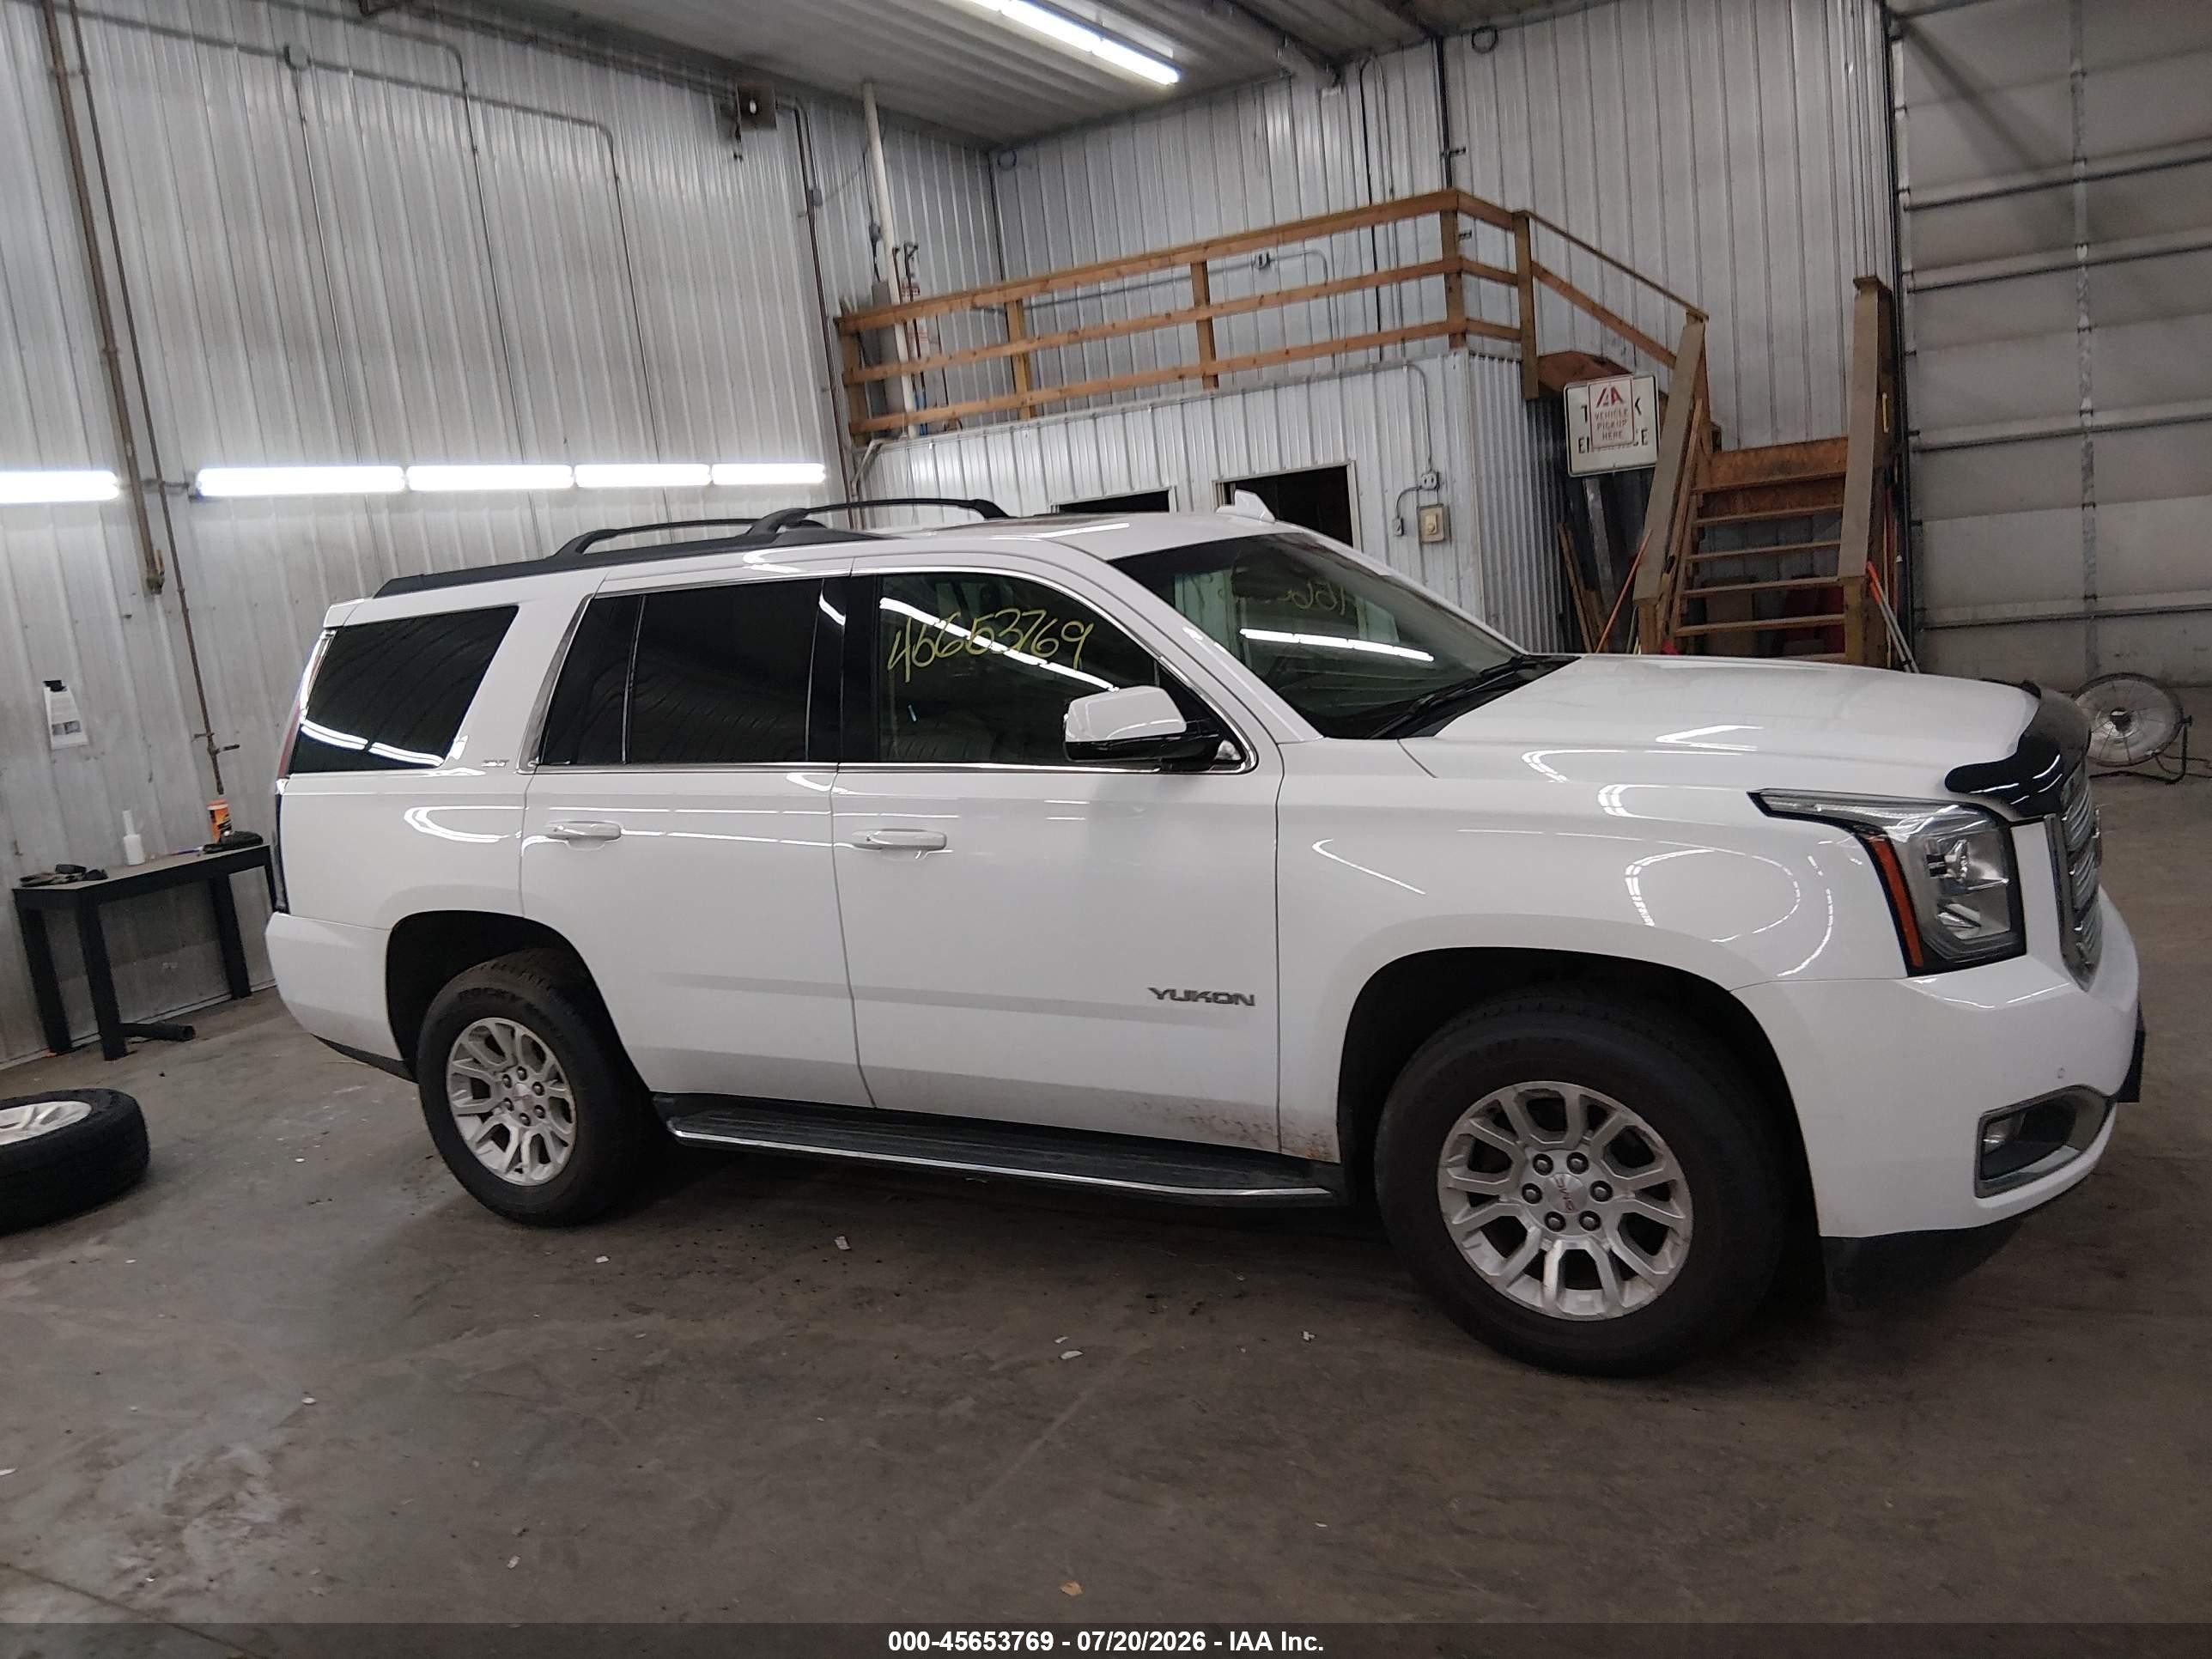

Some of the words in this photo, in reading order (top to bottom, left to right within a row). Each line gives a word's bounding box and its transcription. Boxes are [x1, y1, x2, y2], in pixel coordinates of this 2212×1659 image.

[1596, 418, 1627, 430] PICKUP
[1601, 430, 1623, 441] HERE
[1147, 987, 1255, 1006] YUKON
